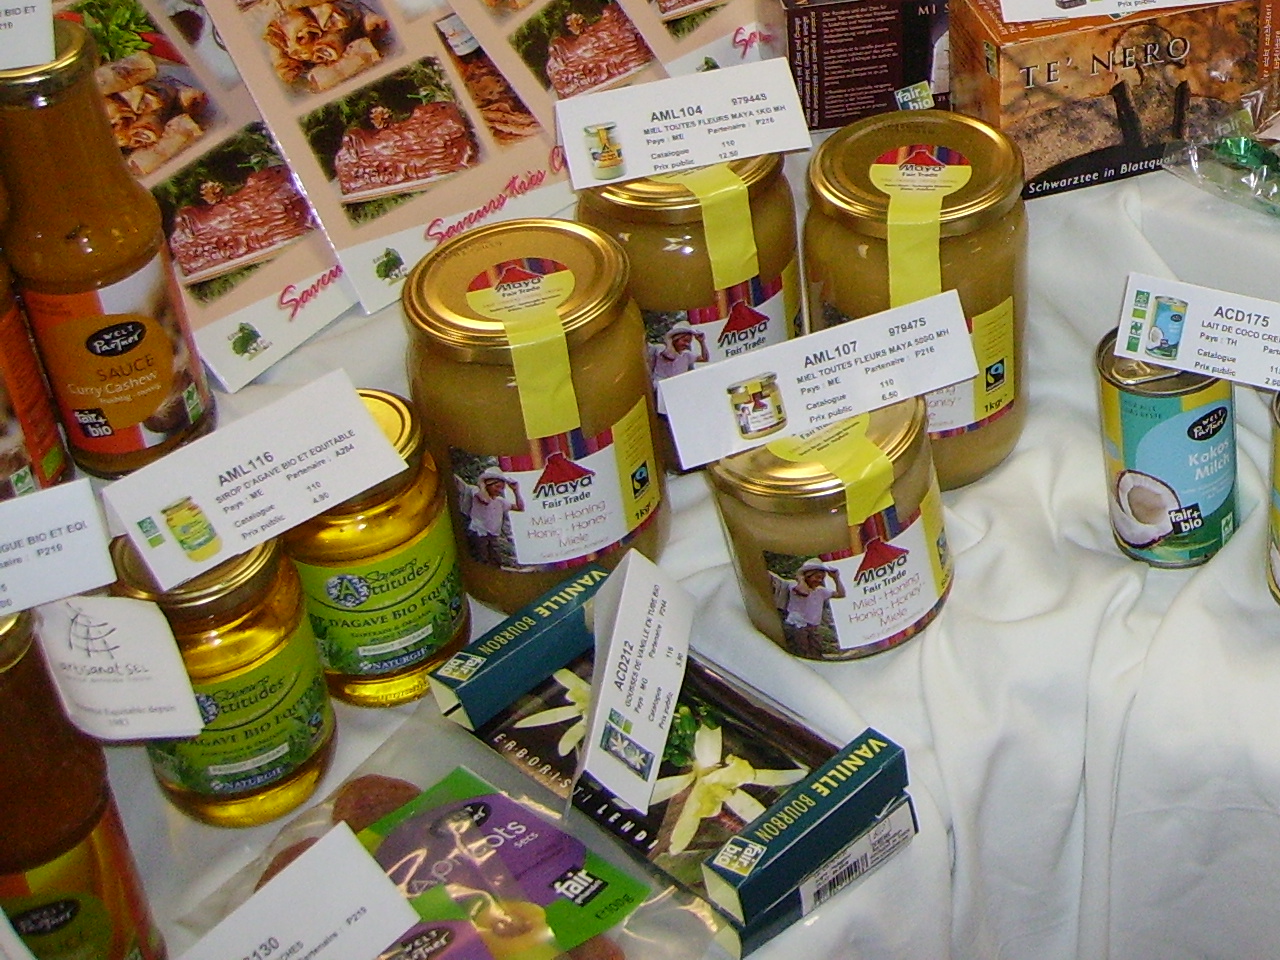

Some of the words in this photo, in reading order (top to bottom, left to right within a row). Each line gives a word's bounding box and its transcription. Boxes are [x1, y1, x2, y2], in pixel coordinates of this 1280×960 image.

[1090, 37, 1190, 76] NERO
[644, 126, 662, 135] MIEL
[664, 120, 696, 132] TOUTES
[698, 114, 729, 127] FLEURS
[731, 111, 754, 123] MAYA
[651, 105, 703, 122] AML104
[899, 163, 946, 172] Maya
[1028, 170, 1100, 194] Schwarztee
[1104, 167, 1114, 179] in
[1201, 321, 1220, 333] LAIT
[1235, 328, 1260, 340] COCO
[1214, 306, 1270, 328] ACD175
[719, 321, 768, 347] Maya
[797, 372, 818, 384] MIEL
[820, 360, 853, 378] TOUTES
[854, 350, 887, 368] FLEURS
[888, 341, 913, 357] MAYA
[804, 340, 858, 368] AML107
[1197, 348, 1236, 364] Catalogue
[97, 354, 155, 382] SAUCE
[68, 381, 102, 398] Curry
[105, 370, 158, 394] Cashew
[88, 424, 113, 437] bio
[215, 483, 244, 504] SIROP
[245, 468, 280, 489] D'AGAVE
[281, 459, 299, 474] BIO
[309, 429, 355, 459] EQUITABLE
[1188, 441, 1229, 467] Kokos
[1194, 454, 1231, 481] Milch
[217, 451, 275, 486] AML116
[533, 477, 592, 500] Maya
[542, 499, 562, 510] Fair
[564, 491, 591, 506] Trade
[1182, 517, 1202, 533] bio
[858, 554, 907, 585] Maya
[863, 585, 881, 595] Fair
[884, 570, 906, 587] Trade
[533, 568, 610, 617] VANILLE
[482, 614, 537, 654] BOURBON
[614, 640, 634, 692] ACD212
[811, 739, 888, 796] VANILLE
[757, 792, 816, 842] BOURBON
